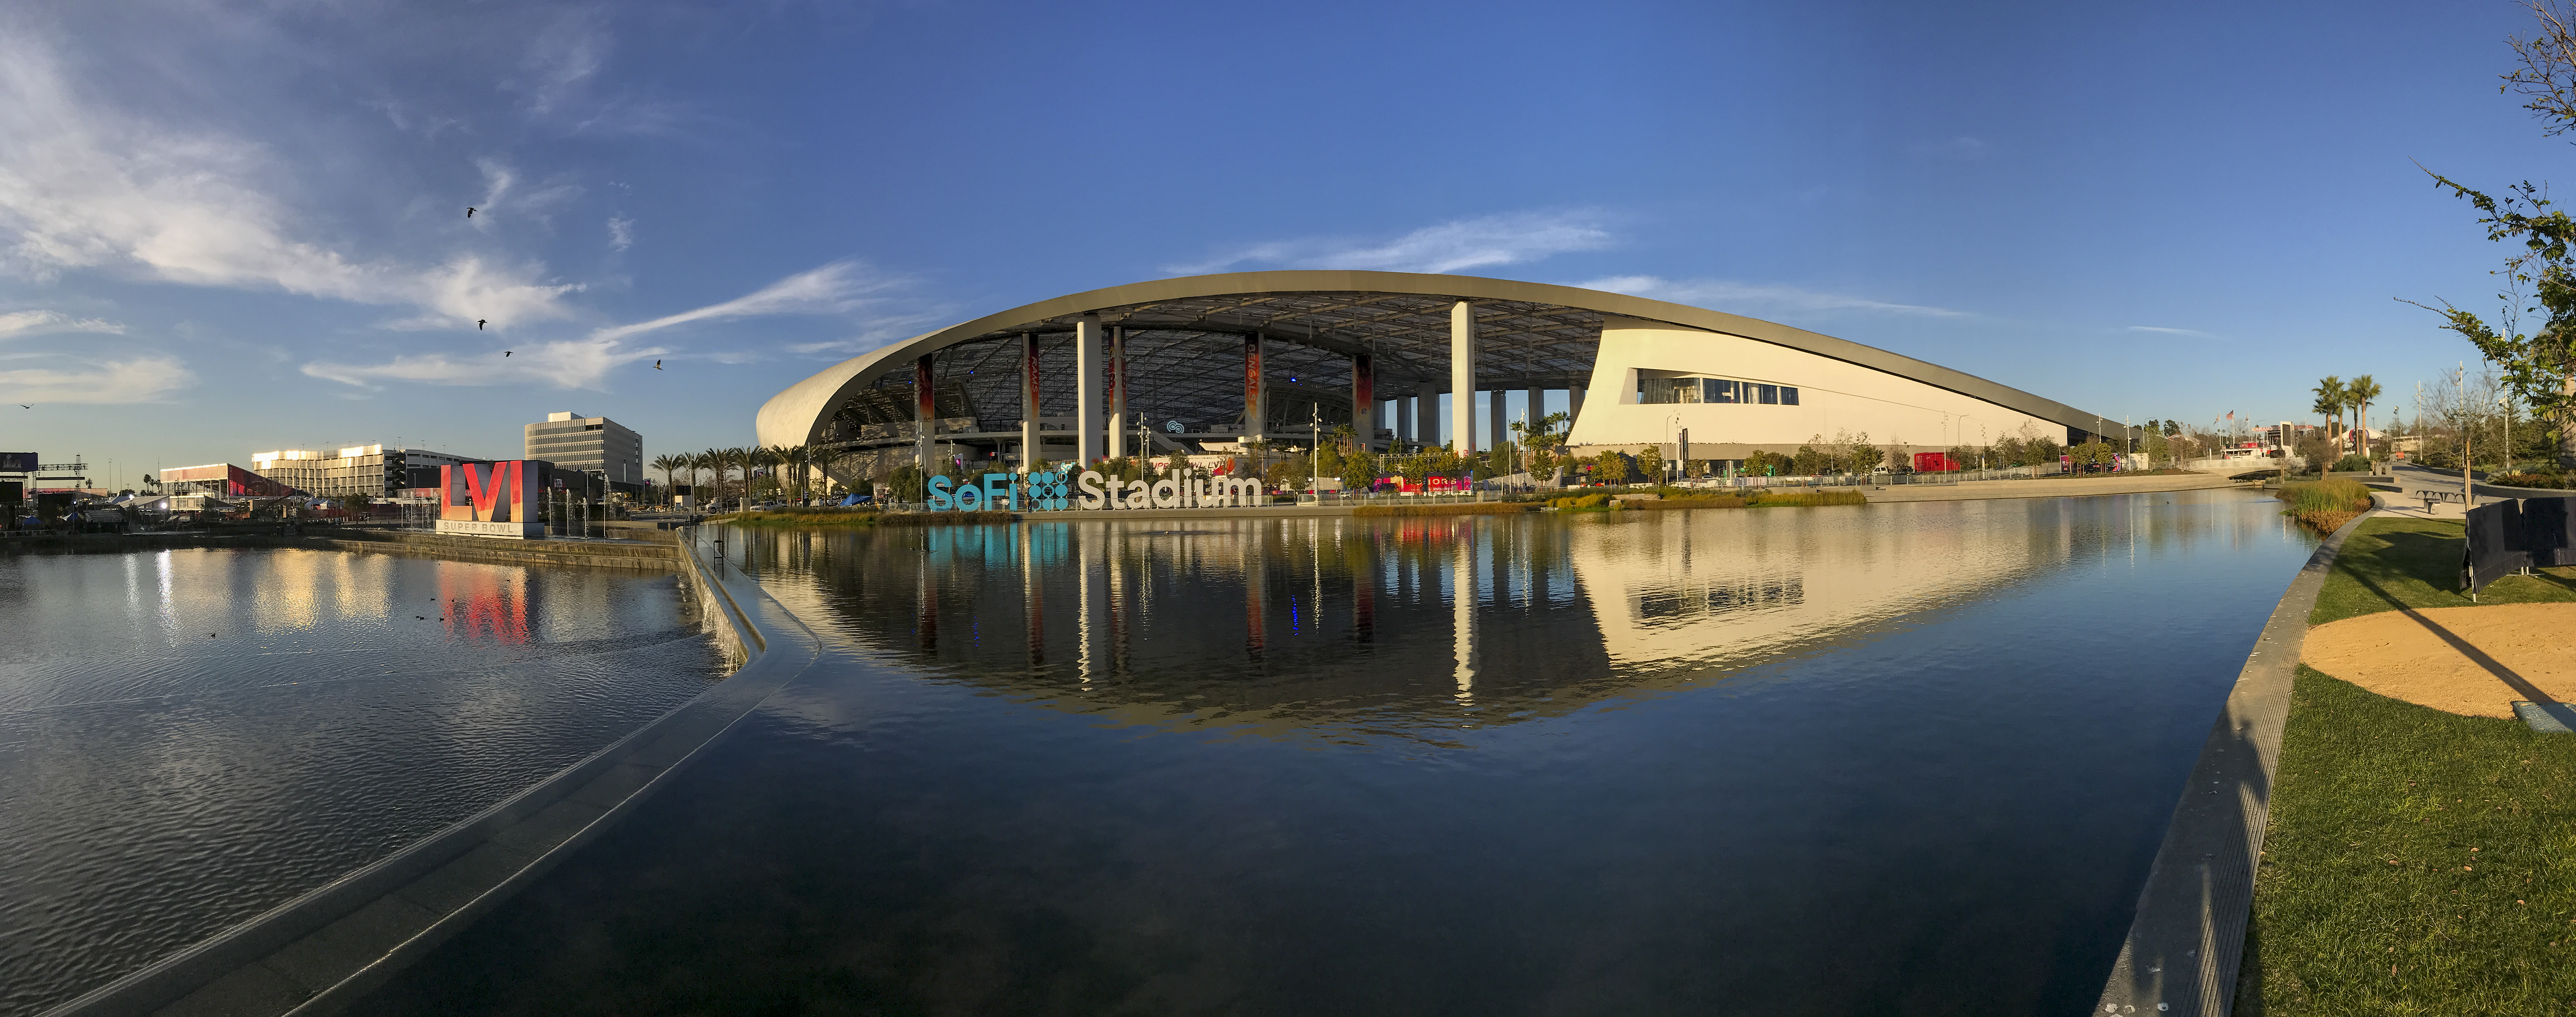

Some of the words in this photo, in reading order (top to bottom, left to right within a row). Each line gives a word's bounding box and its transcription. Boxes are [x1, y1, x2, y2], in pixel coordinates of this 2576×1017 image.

[1248, 344, 1256, 401] BENGALS
[441, 460, 523, 522] LVI
[927, 472, 1018, 512] SoFi
[1078, 468, 1262, 510] Stadium
[444, 522, 477, 531] SUPER
[482, 524, 513, 534] BOWL
